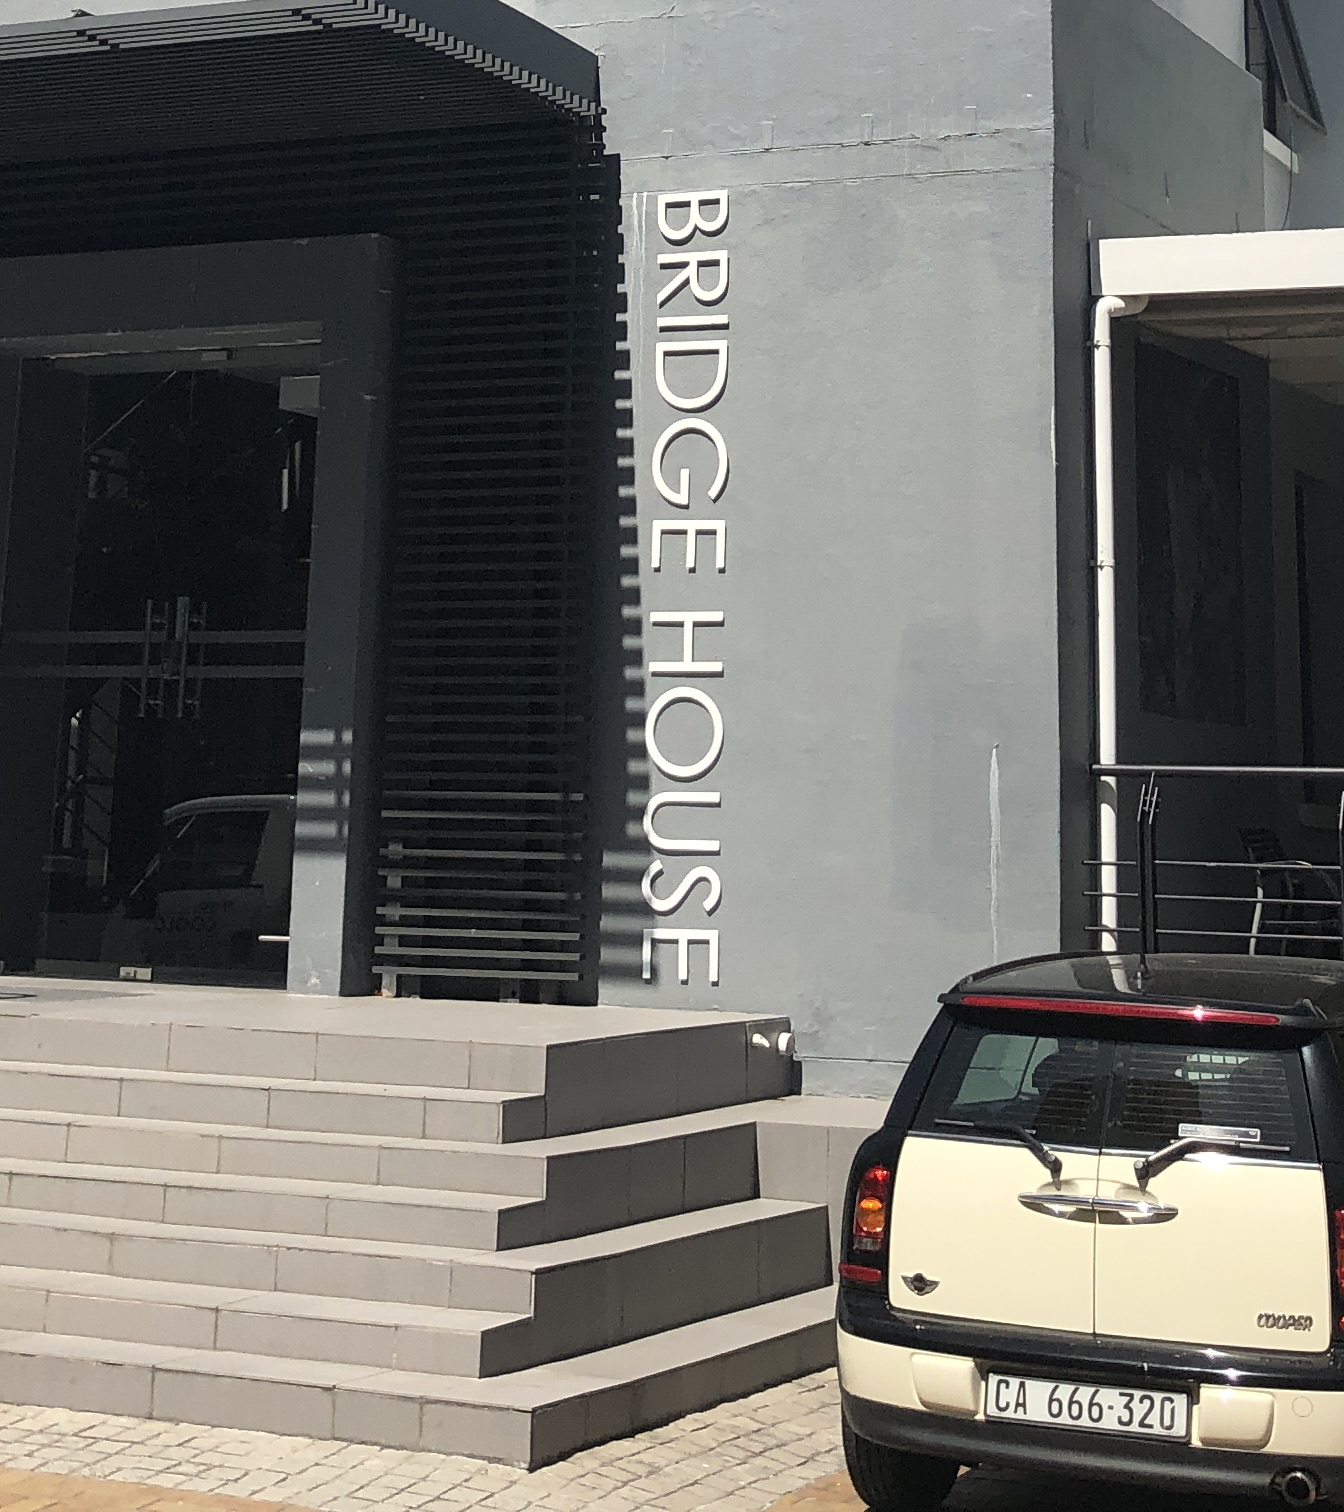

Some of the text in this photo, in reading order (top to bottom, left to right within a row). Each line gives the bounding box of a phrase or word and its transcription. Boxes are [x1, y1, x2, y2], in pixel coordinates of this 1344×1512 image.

[642, 188, 729, 987] BRIDGE HOUSE
[1257, 1312, 1313, 1331] COOPER
[995, 1378, 1027, 1415] CA
